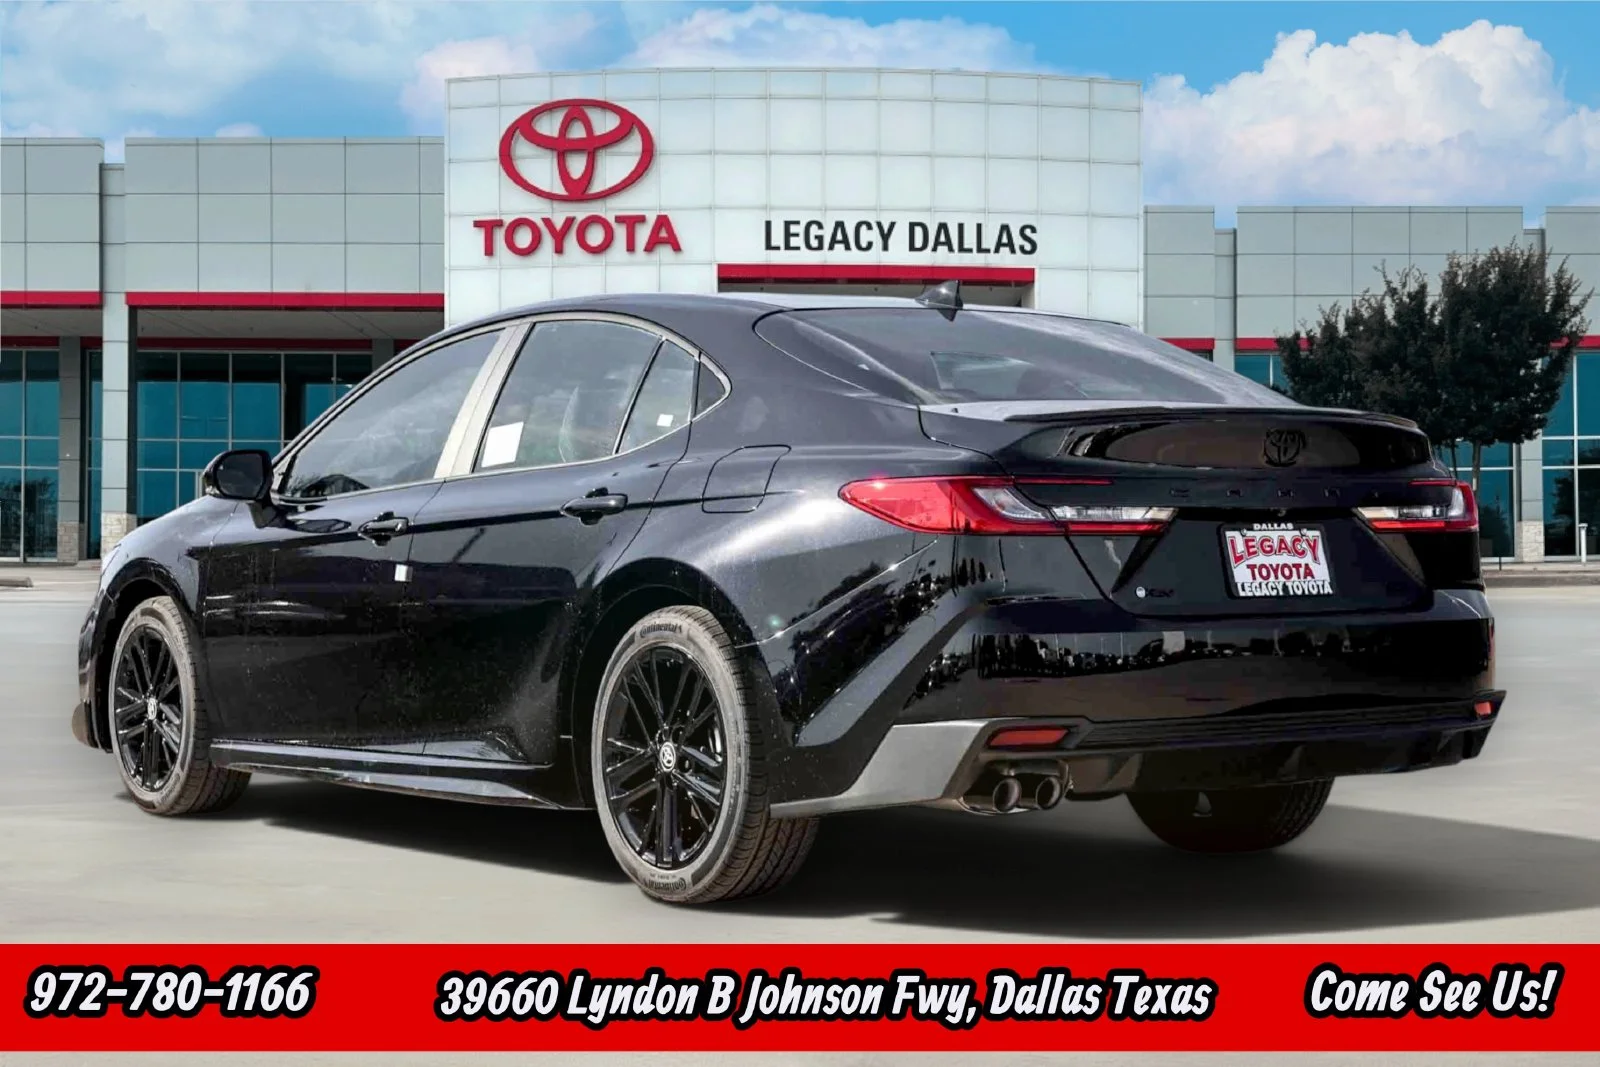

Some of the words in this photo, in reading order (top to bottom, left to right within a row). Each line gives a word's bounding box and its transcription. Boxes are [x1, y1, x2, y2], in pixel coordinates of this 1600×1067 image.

[474, 214, 681, 257] TOYOTA
[765, 220, 897, 252] LEGACY
[908, 221, 1038, 255] DALLAS
[1253, 522, 1294, 531] DALLAS
[1227, 534, 1321, 568] LEGACY
[1247, 562, 1315, 580] TOYOTA
[1237, 581, 1286, 596] LEGACY
[1286, 580, 1333, 595] TOYOTA
